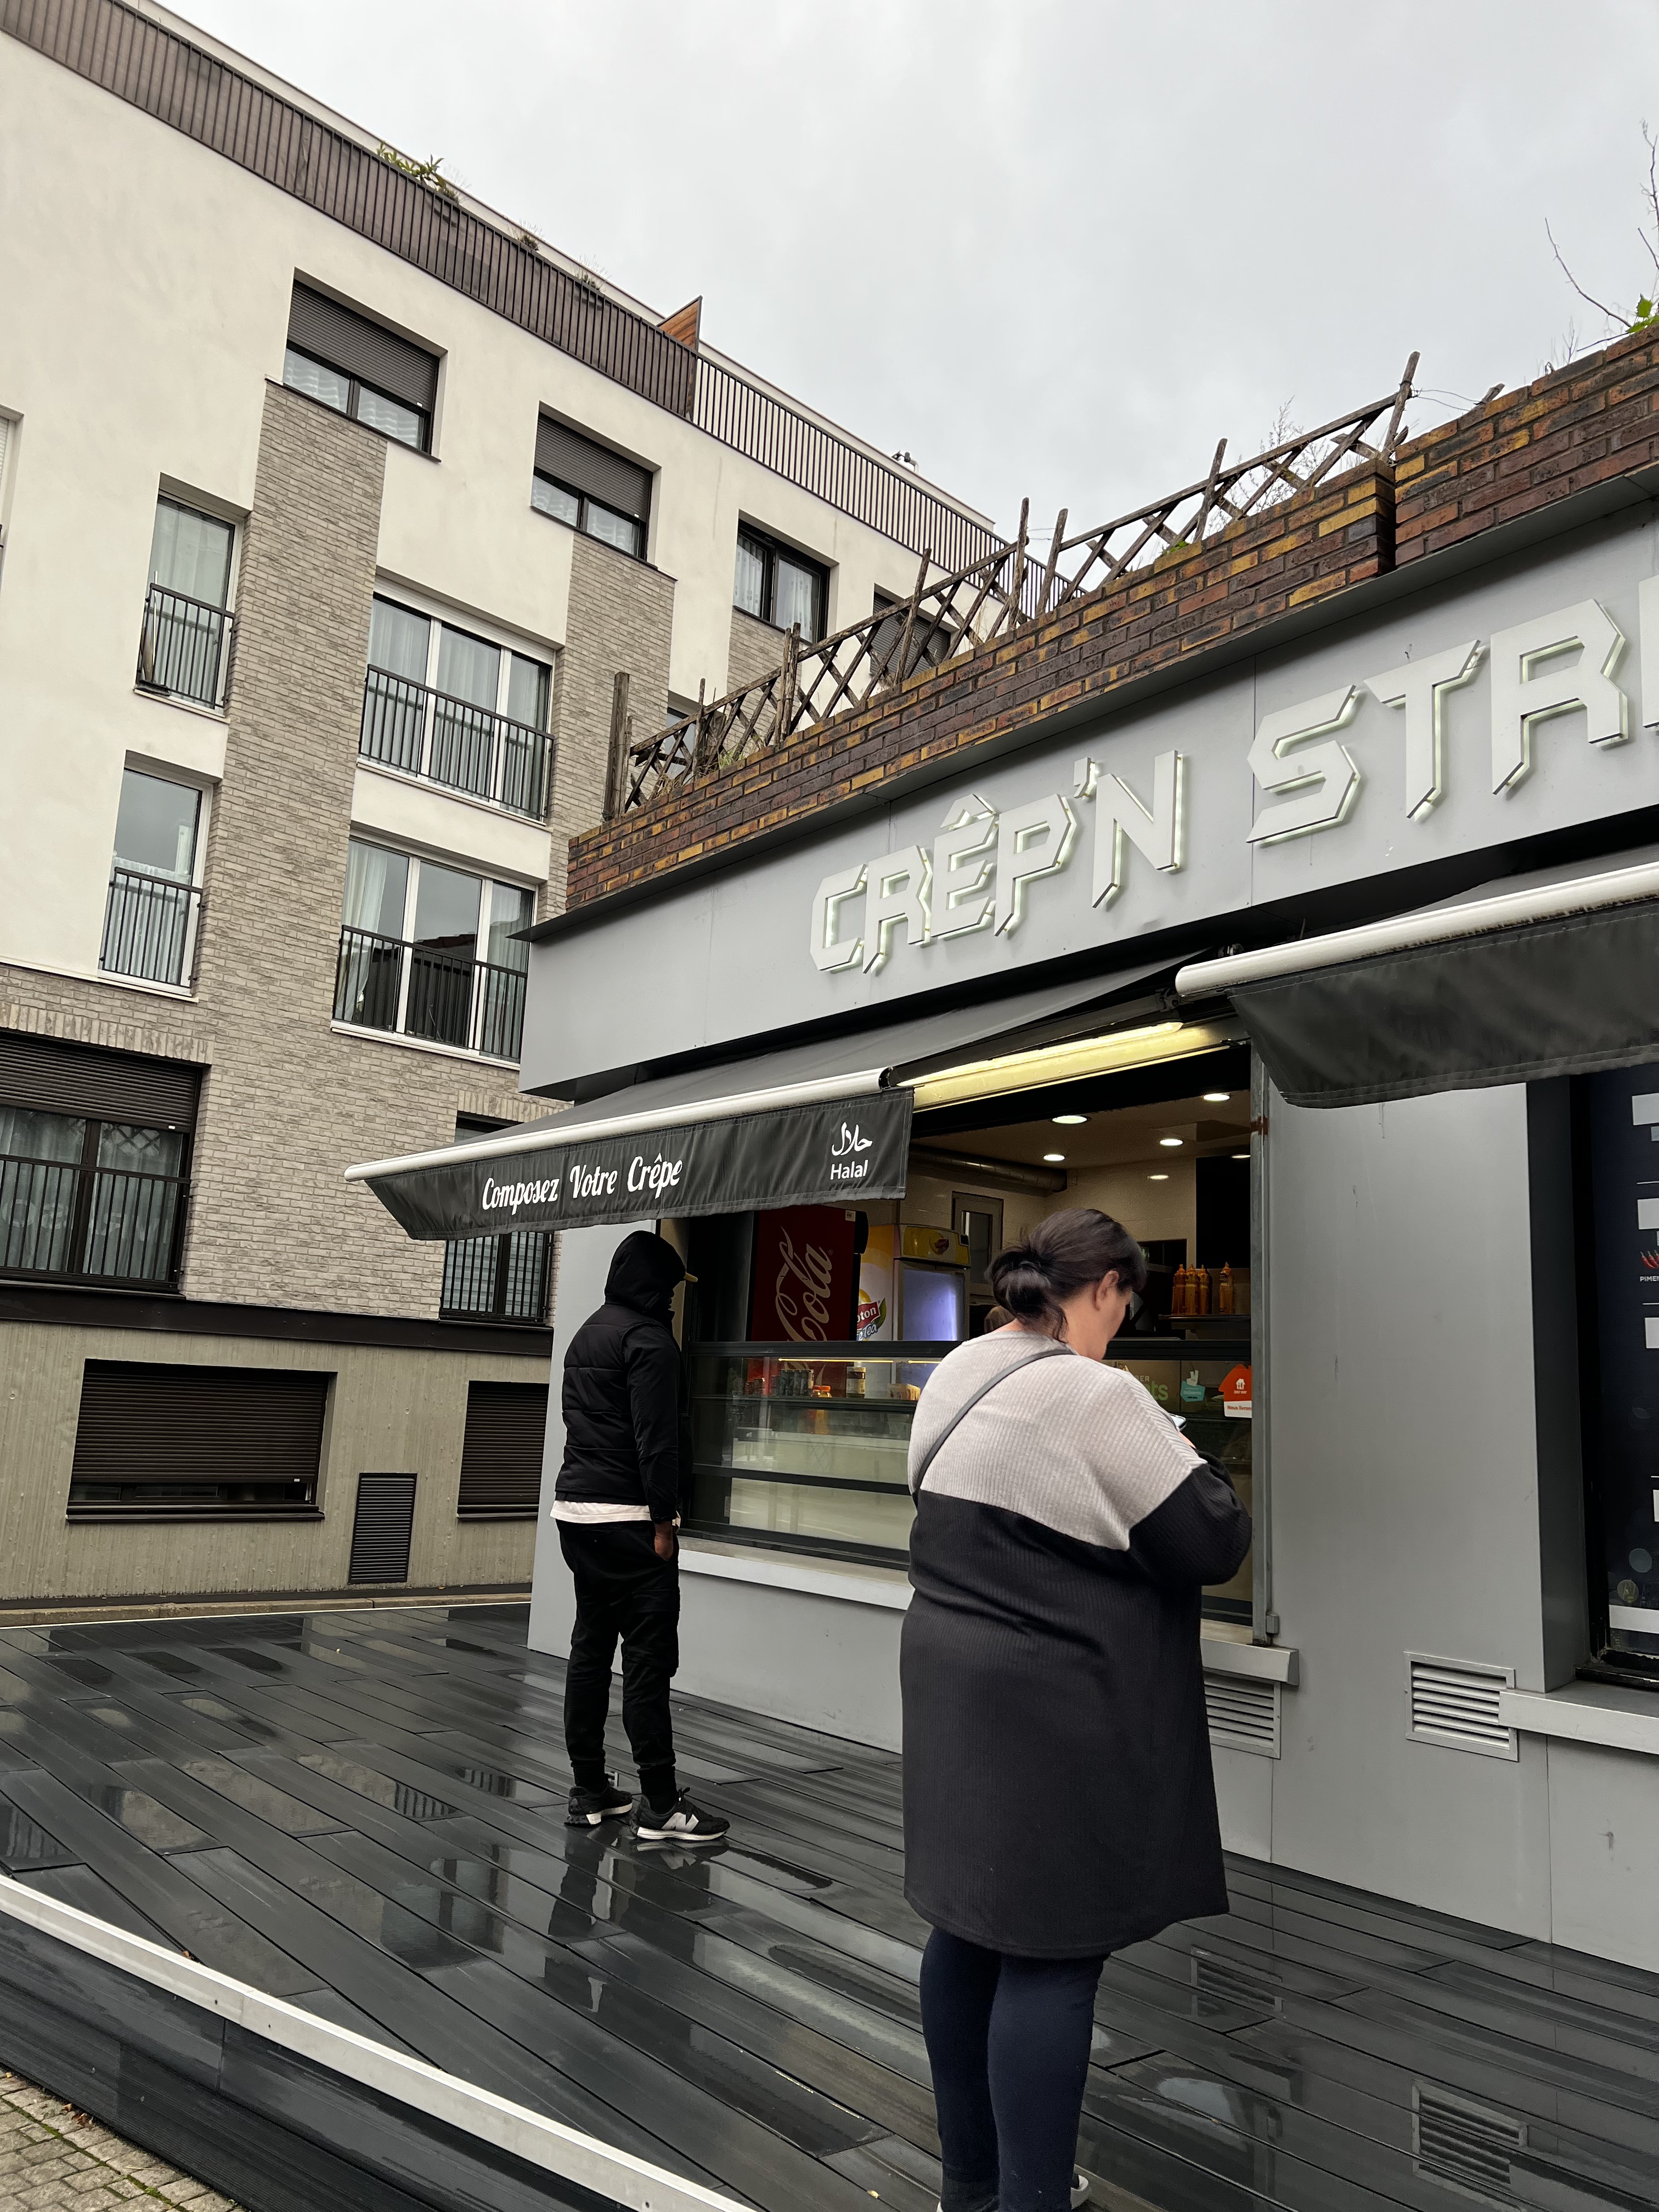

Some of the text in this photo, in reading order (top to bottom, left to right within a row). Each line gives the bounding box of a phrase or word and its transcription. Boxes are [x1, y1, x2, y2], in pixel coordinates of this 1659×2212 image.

[810, 575, 1659, 975] CRÊP'N STR
[831, 1122, 873, 1156] حلال
[482, 1152, 683, 1215] Composez Votre Crêpe
[830, 1159, 868, 1180] Halal
